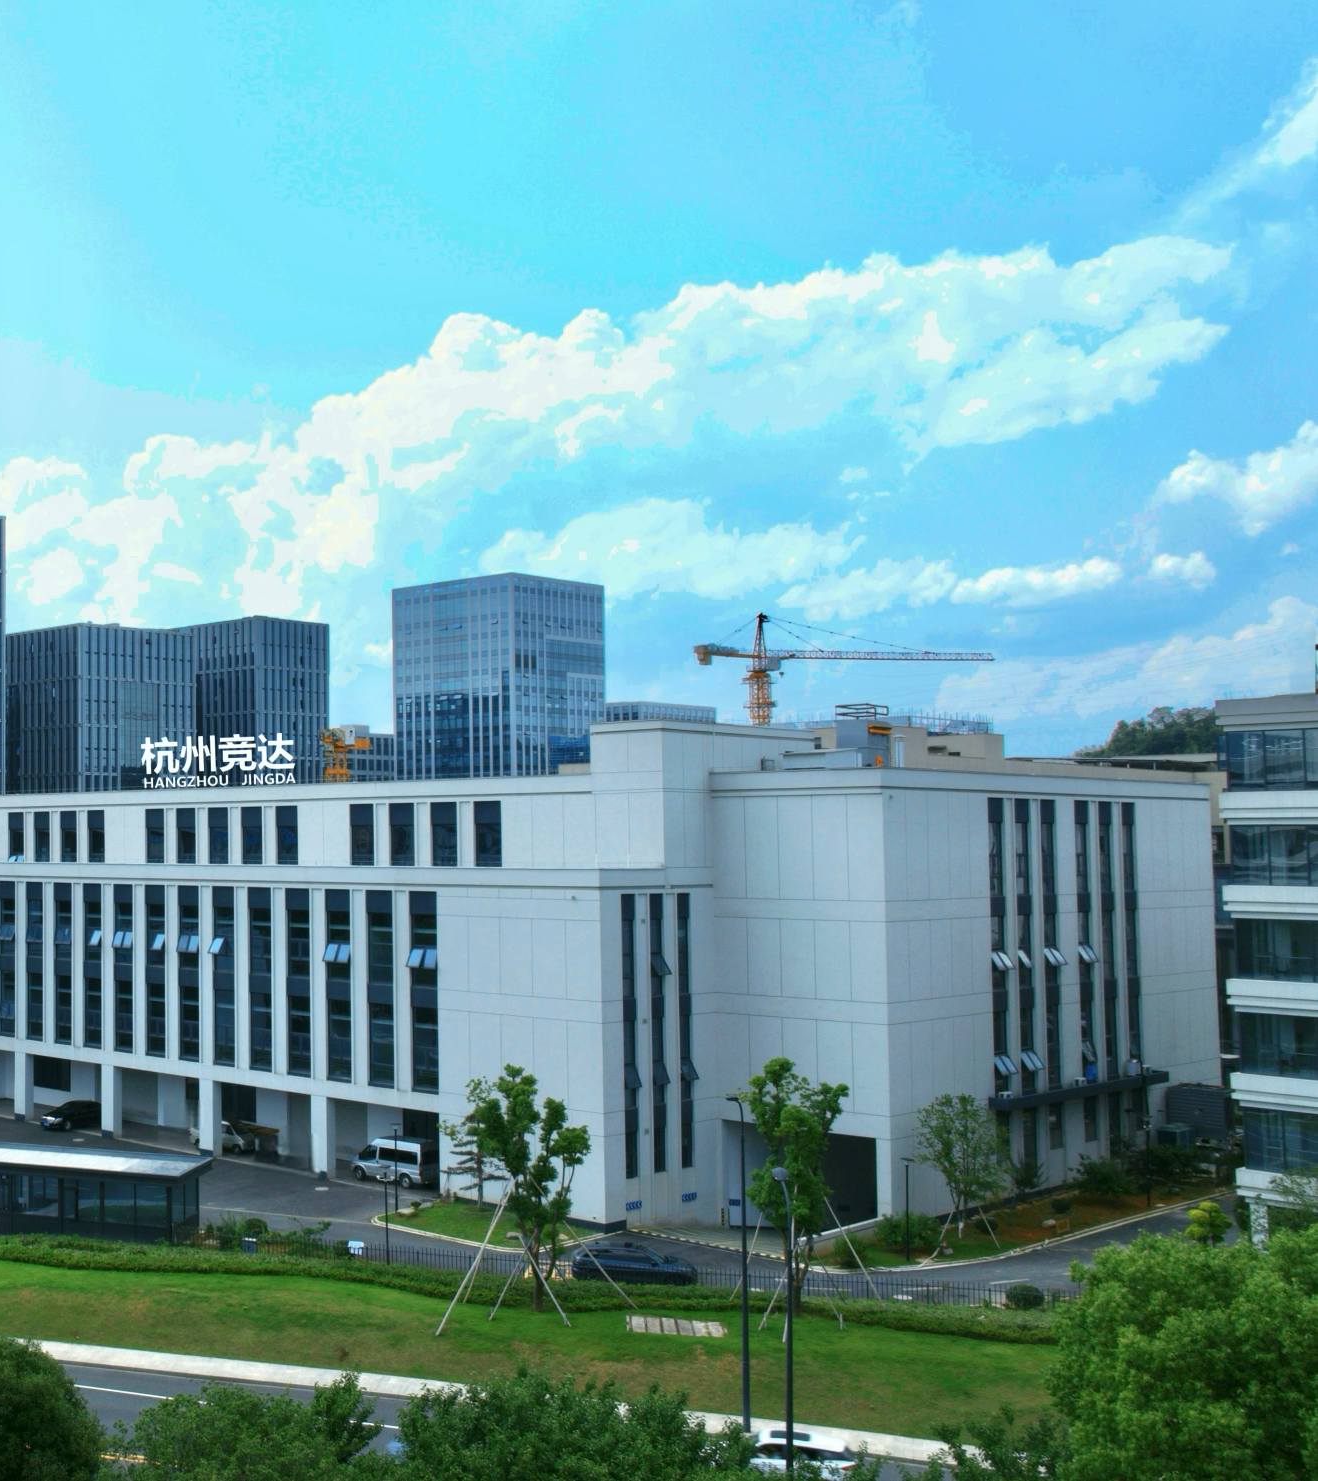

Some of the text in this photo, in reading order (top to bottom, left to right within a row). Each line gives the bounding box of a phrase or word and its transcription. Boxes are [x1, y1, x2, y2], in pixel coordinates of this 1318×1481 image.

[141, 733, 295, 775] 杭州竞达
[143, 772, 296, 789] HANGZHOU JINGDA
